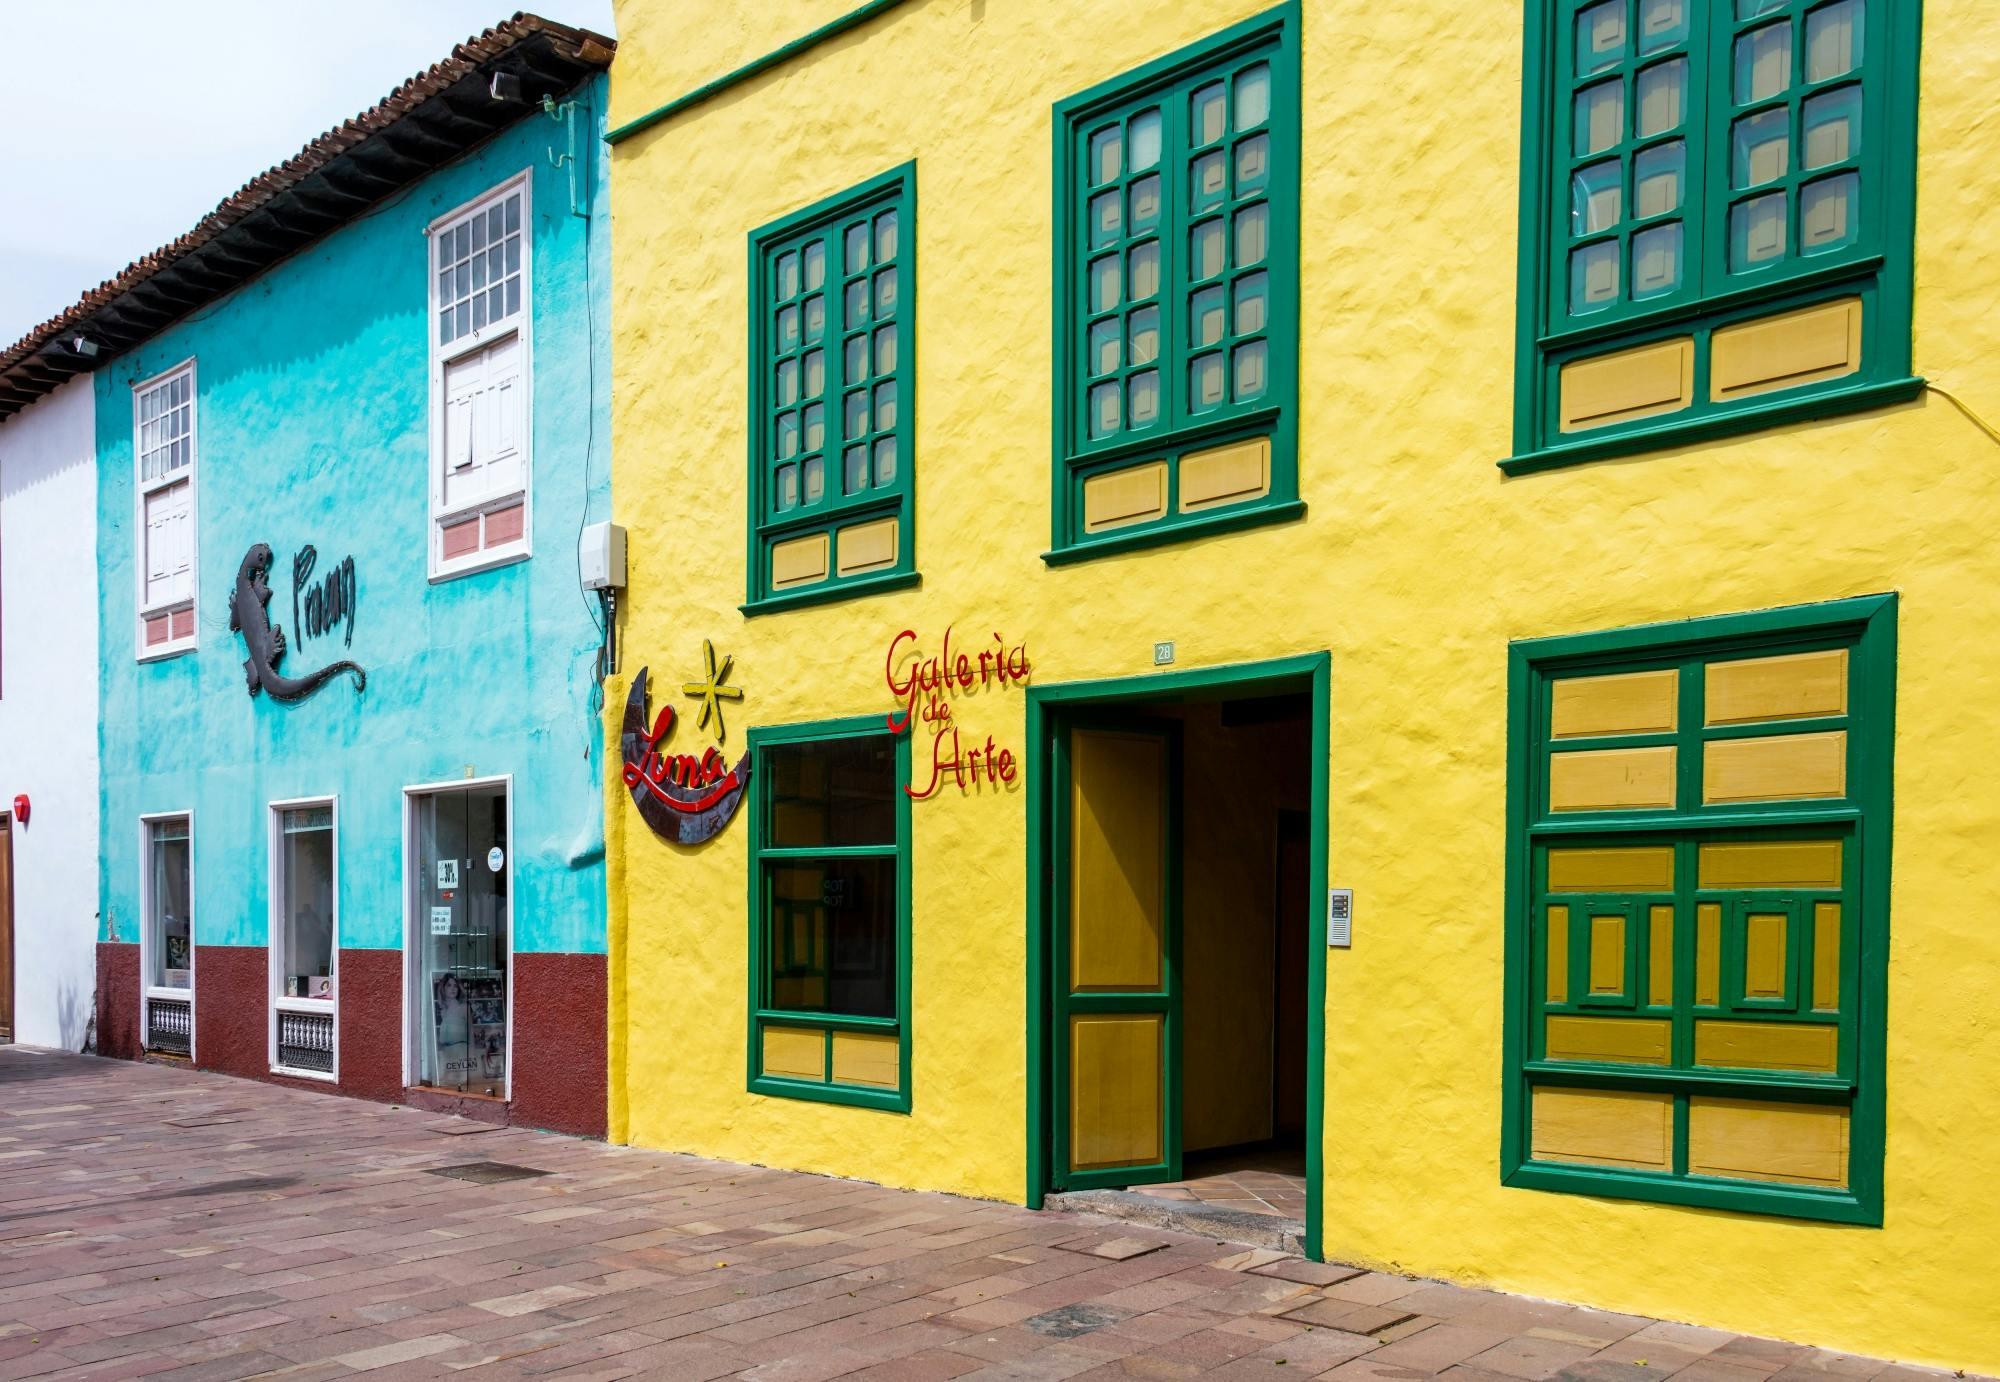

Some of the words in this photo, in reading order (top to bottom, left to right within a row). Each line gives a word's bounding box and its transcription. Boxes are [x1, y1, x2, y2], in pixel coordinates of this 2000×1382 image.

[1158, 645, 1171, 660] 28
[922, 694, 951, 722] de
[623, 704, 740, 812] Luna
[903, 726, 1017, 798] Arte
[446, 1060, 478, 1070] CEYLAN
